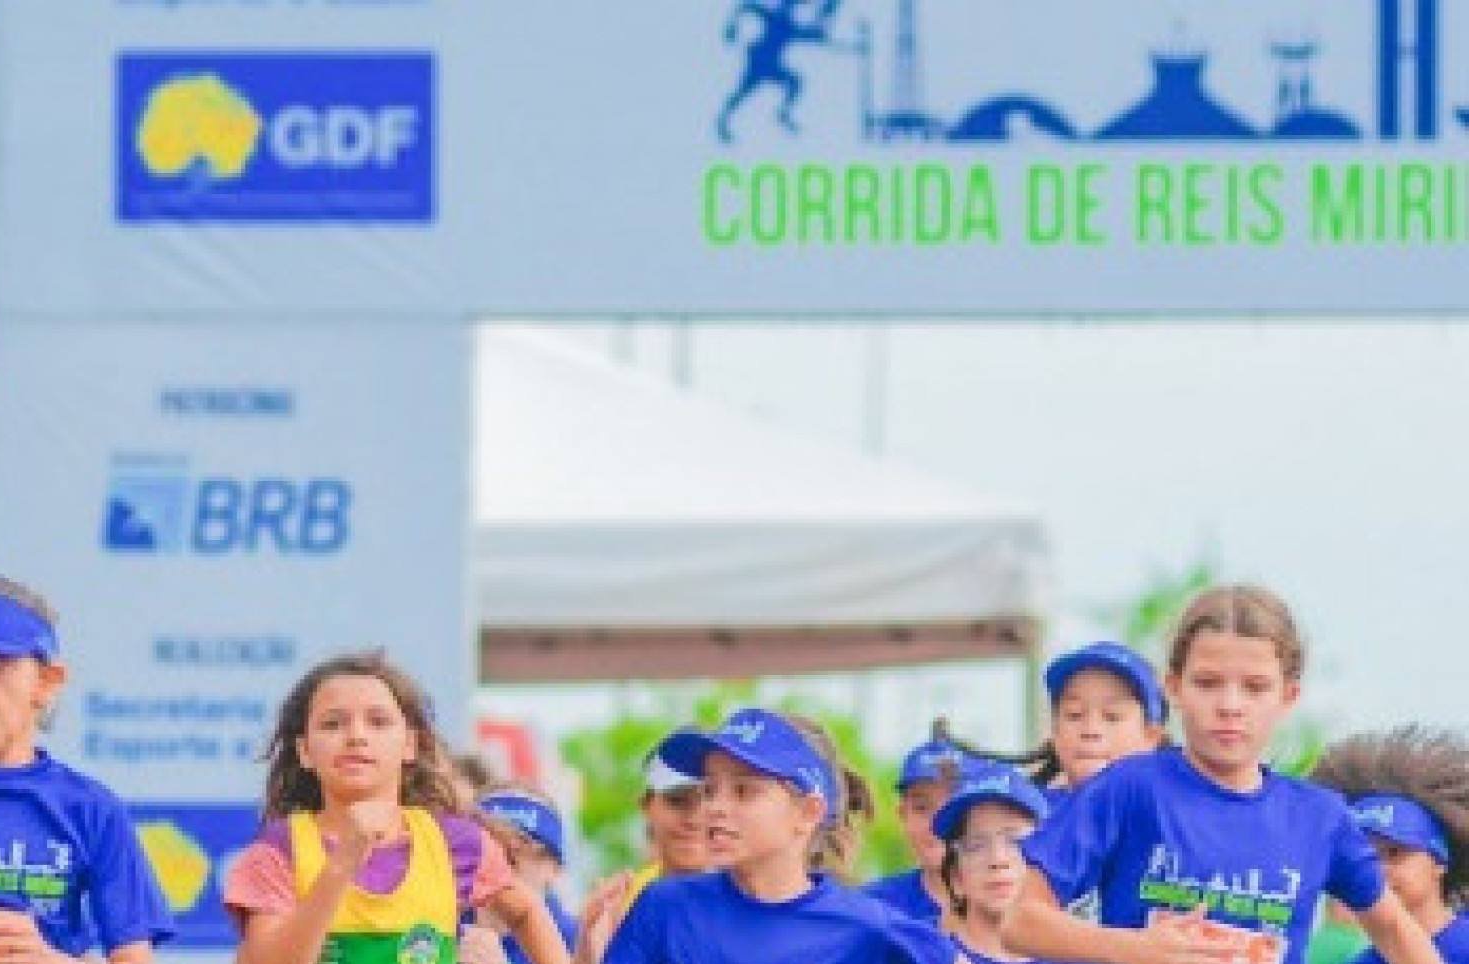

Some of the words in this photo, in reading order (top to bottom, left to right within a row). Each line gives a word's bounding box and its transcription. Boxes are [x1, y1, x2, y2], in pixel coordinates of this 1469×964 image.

[270, 106, 418, 168] GDF
[701, 163, 1000, 246] CORRIDA
[1026, 163, 1106, 245] DE
[1136, 163, 1284, 246] REIS
[1311, 163, 1469, 245] MIRI
[192, 477, 350, 553] BRB
